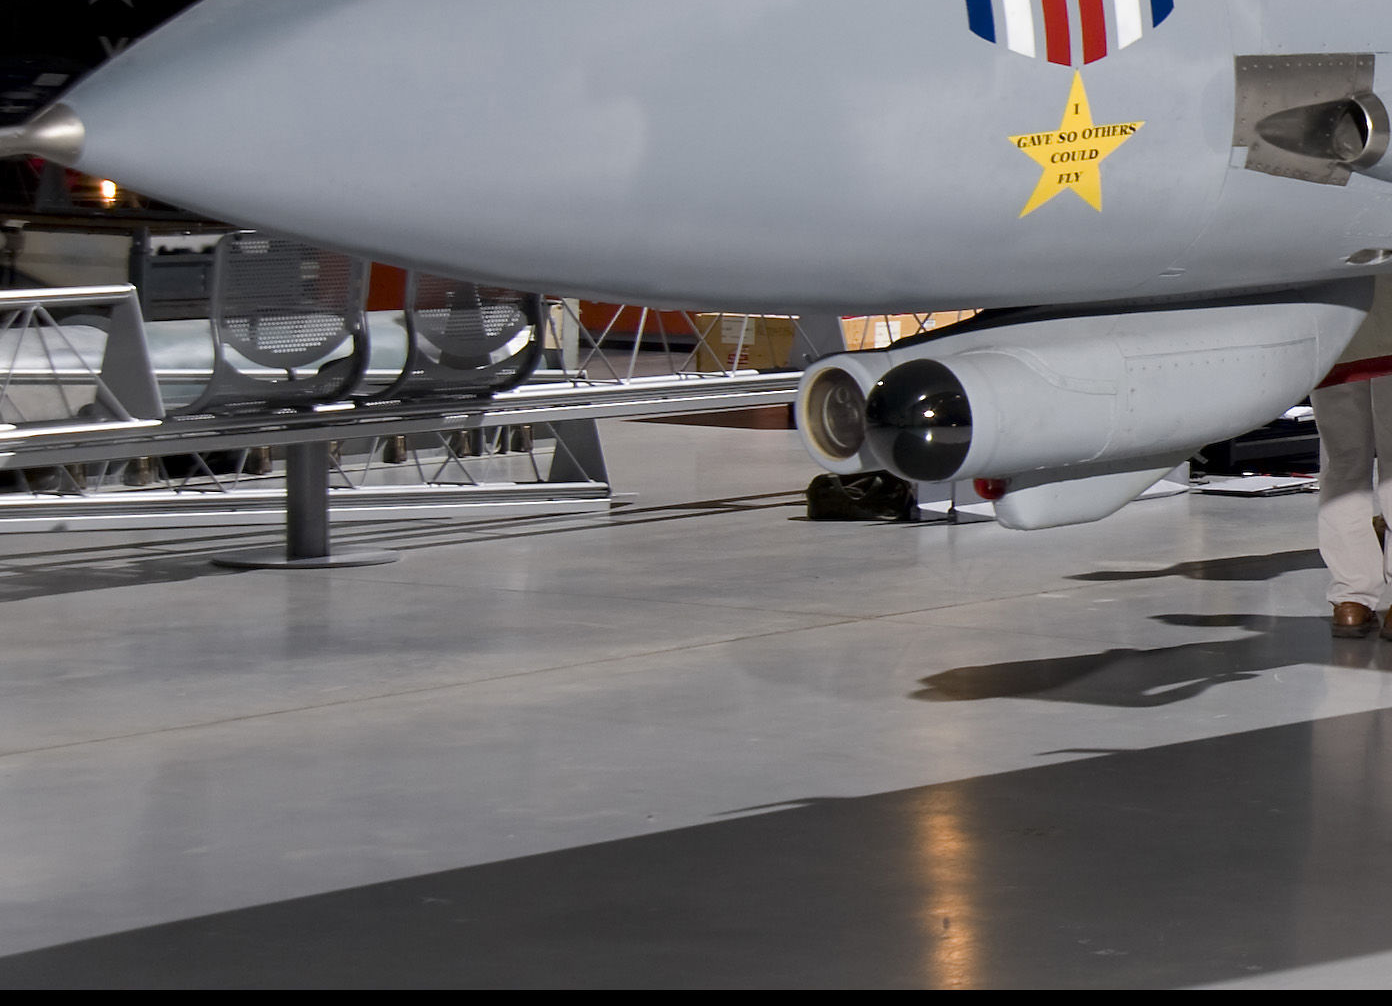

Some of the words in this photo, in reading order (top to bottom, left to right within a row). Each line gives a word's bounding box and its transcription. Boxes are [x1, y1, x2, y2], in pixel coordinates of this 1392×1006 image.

[1073, 103, 1080, 115] I
[1017, 133, 1053, 148] GAVE
[1057, 131, 1077, 143] SO
[1082, 123, 1137, 140] OTHERS
[1050, 148, 1099, 164] COULD
[1057, 171, 1083, 184] FLY
